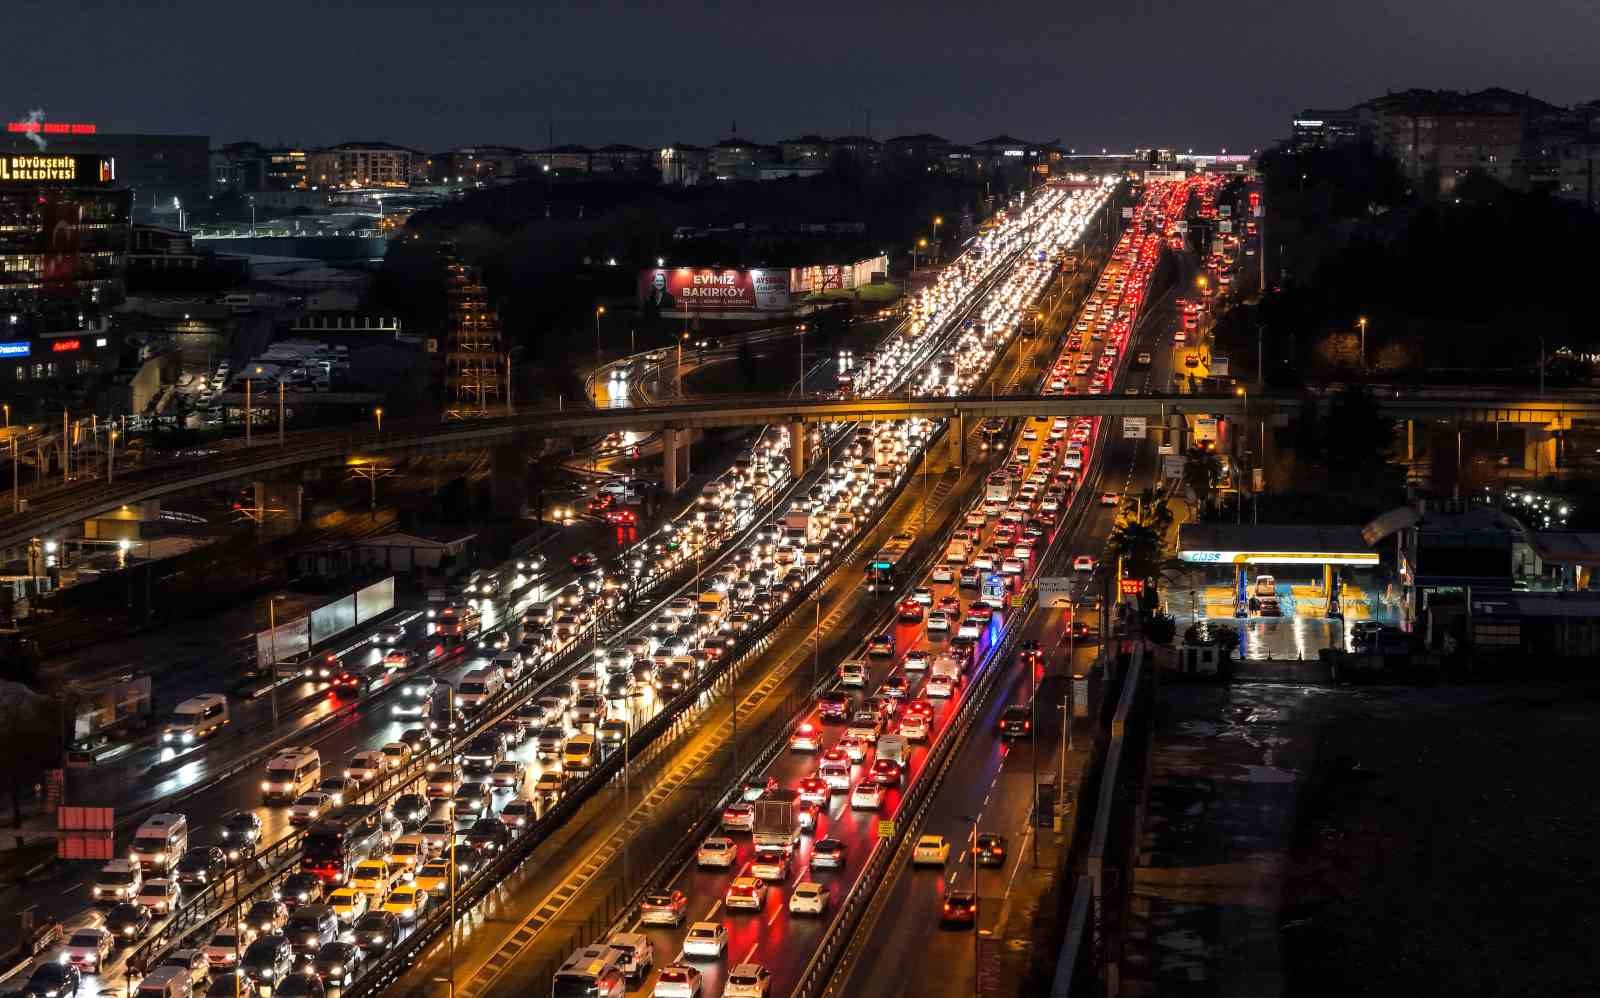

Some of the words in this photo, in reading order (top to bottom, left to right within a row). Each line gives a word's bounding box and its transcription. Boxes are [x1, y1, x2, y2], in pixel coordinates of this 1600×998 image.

[12, 168, 75, 180] BELEDİYESİ
[693, 272, 735, 285] EVİMİZ
[682, 285, 746, 297] BAKIRKÖY
